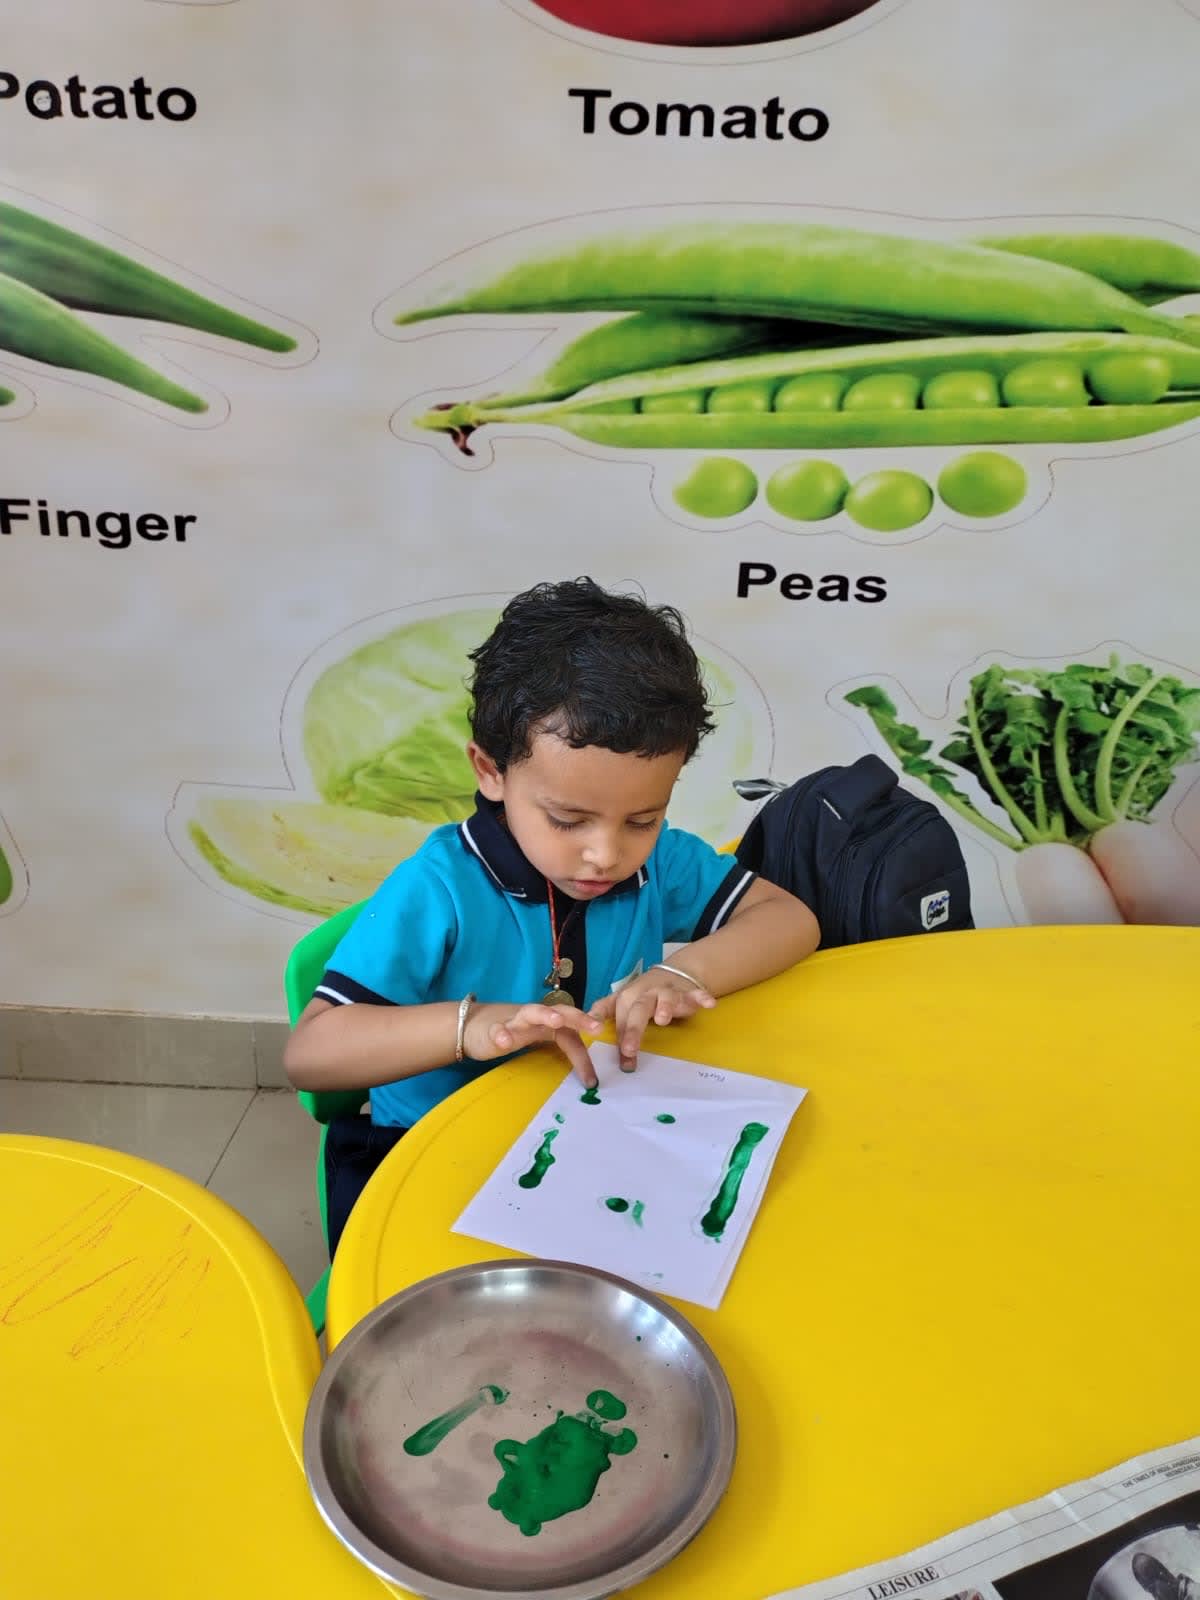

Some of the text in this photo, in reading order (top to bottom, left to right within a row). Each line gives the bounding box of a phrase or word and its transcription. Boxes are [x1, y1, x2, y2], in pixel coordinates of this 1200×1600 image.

[567, 88, 830, 142] Tomato
[0, 497, 198, 550] Finger
[737, 562, 887, 604] Peas
[868, 1566, 940, 1600] LEISURE
